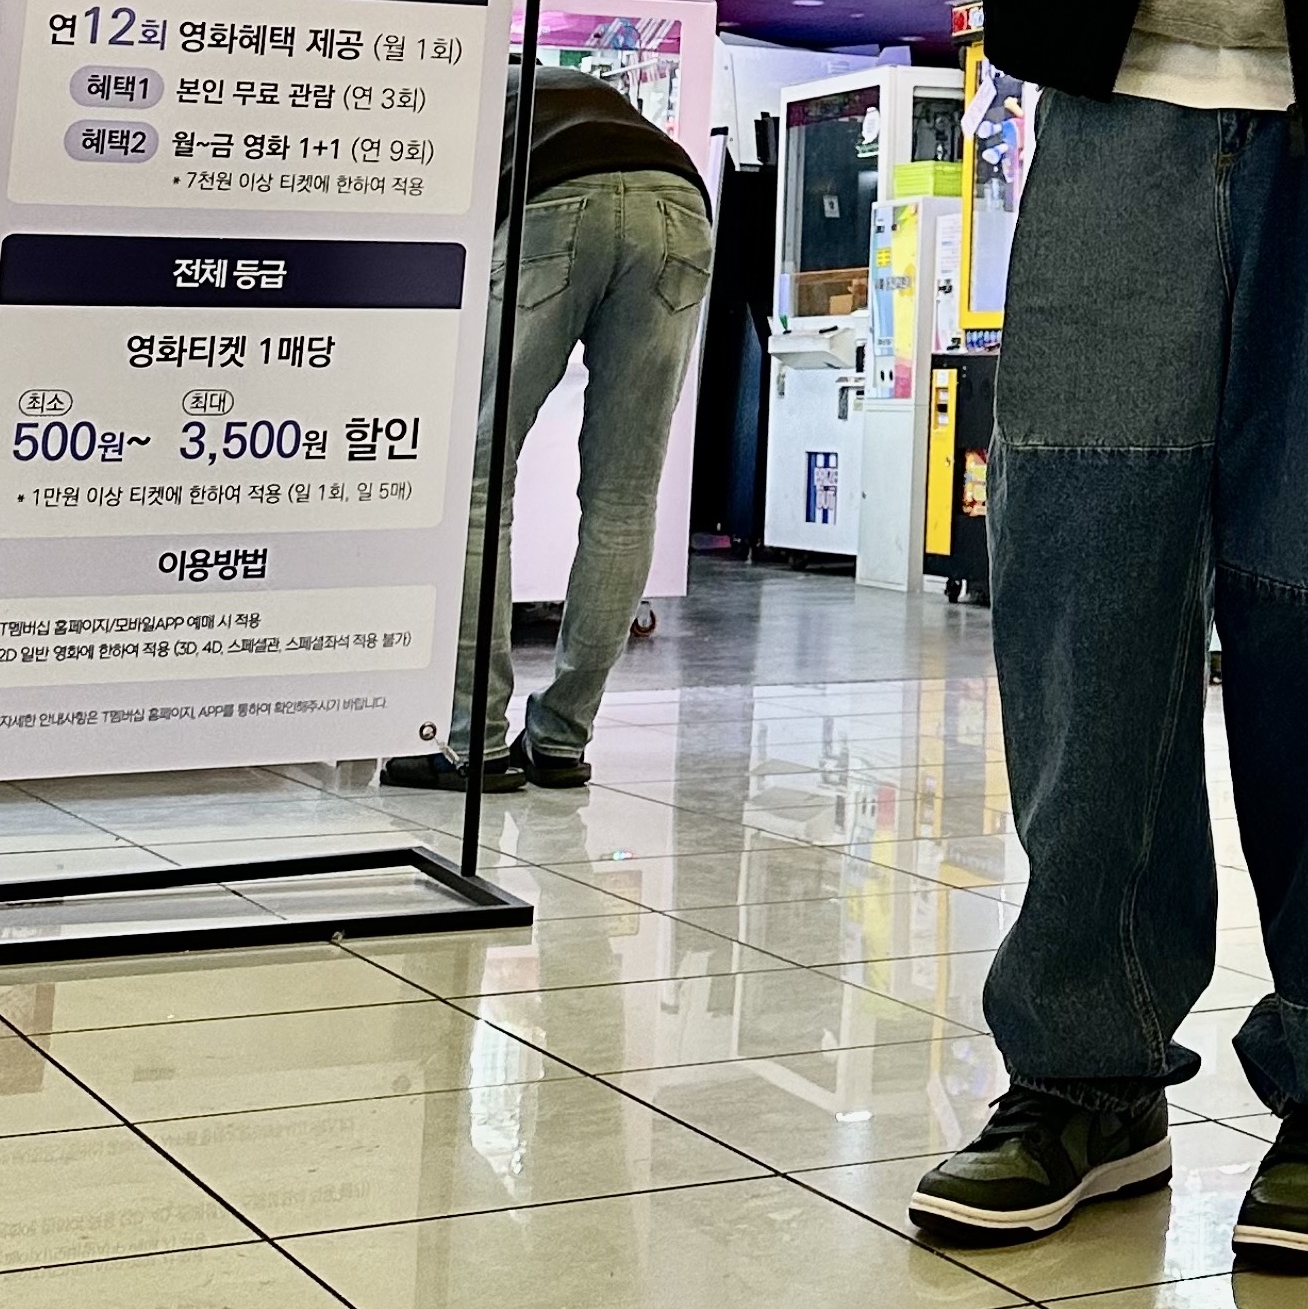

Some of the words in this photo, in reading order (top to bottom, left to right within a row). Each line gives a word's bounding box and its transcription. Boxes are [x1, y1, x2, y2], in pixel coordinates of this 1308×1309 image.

[178, 20, 295, 57] 영화혜택
[306, 27, 364, 61] 제공
[372, 32, 406, 64] (월
[87, 74, 151, 102] 혜택1
[176, 77, 225, 105] 본인
[232, 80, 281, 108] 무료
[287, 82, 336, 110] 관람
[343, 84, 373, 111] (연
[381, 87, 427, 114] 3회)
[81, 128, 147, 156] 혜택2
[171, 131, 235, 159] 월~금
[243, 134, 291, 161] 영화
[299, 137, 341, 159] 1+1
[351, 137, 382, 164] (연
[389, 138, 435, 165] 9회)
[186, 171, 232, 191] 7천원
[239, 173, 274, 193] 이상
[280, 174, 330, 194] 티켓에
[336, 175, 385, 195] 한하여
[391, 176, 425, 196] 적용
[172, 258, 228, 289] 전체
[232, 259, 288, 289] 등급
[127, 335, 247, 368] 영화티켓
[26, 394, 66, 414] 최소
[189, 393, 229, 413] 최대
[179, 419, 328, 465] 3,500원
[345, 416, 420, 461] 할인
[33, 487, 80, 507] 1만원
[87, 486, 123, 507] 이상
[129, 485, 183, 506] 티켓에
[189, 485, 241, 505] 한하여
[248, 484, 283, 505] 적용
[357, 482, 374, 502] 일
[158, 548, 269, 582] 이용방법
[187, 614, 215, 630] 예매
[217, 613, 232, 629] 시
[235, 613, 262, 629] 적용
[21, 646, 49, 662] 일반
[53, 644, 95, 661] 영화에
[99, 643, 139, 660] 한하여
[142, 641, 170, 658] 적용
[353, 632, 378, 649] 적용
